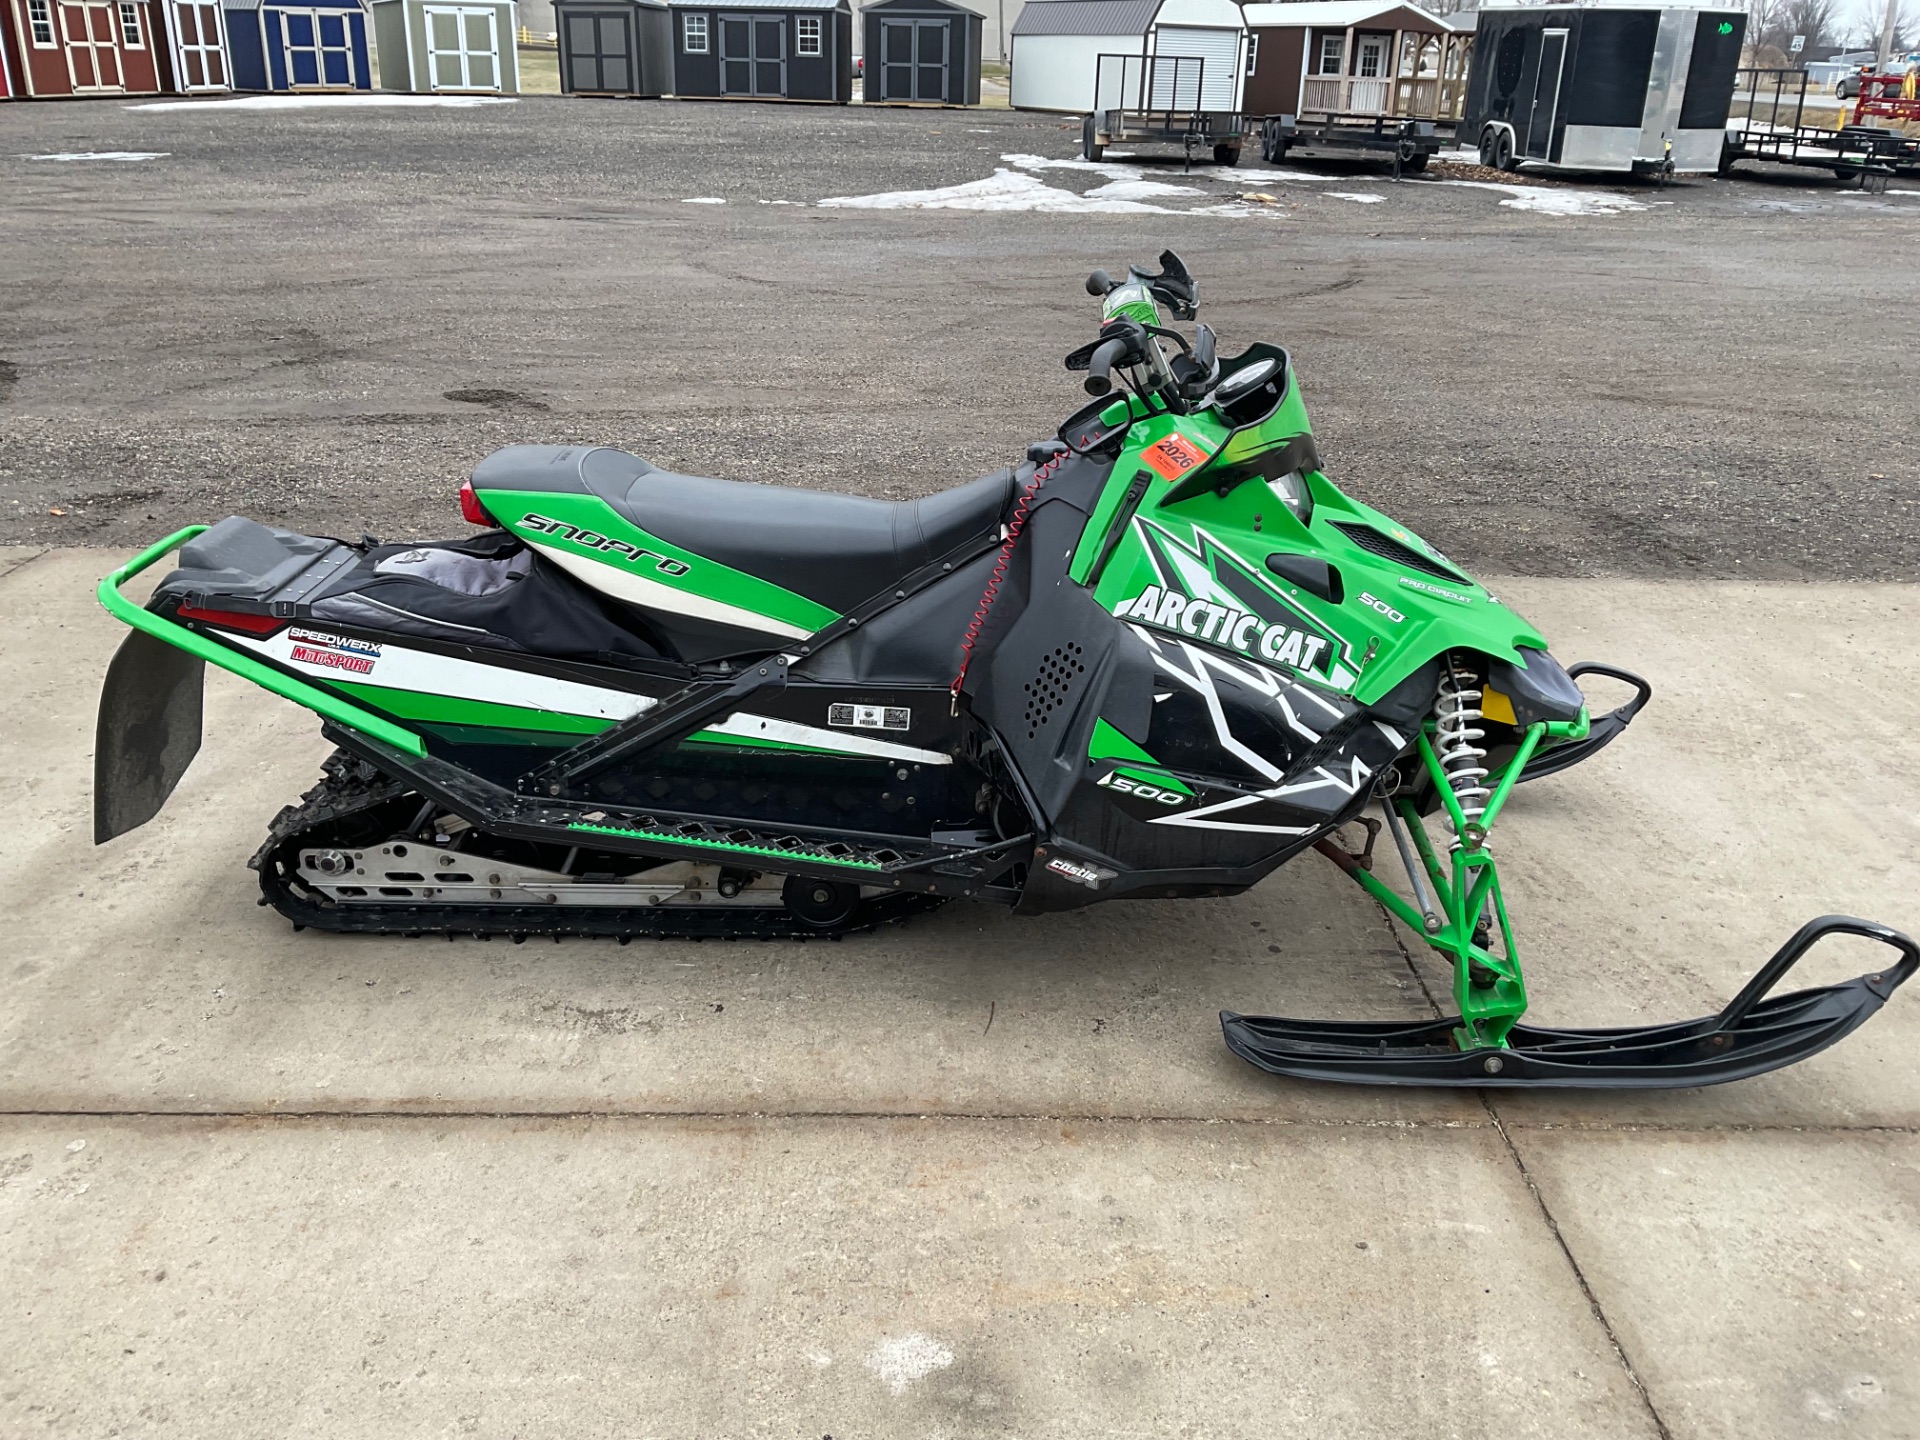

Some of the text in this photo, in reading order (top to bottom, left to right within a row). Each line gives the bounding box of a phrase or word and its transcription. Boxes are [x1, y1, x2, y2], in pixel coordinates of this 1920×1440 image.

[1156, 440, 1195, 469] 2026
[1358, 591, 1407, 624] 500
[1427, 585, 1472, 604] CIRCUIT
[289, 627, 382, 654] SPEEDWERX
[1128, 584, 1328, 672] ARCTIC CAT
[1109, 777, 1185, 806] 500
